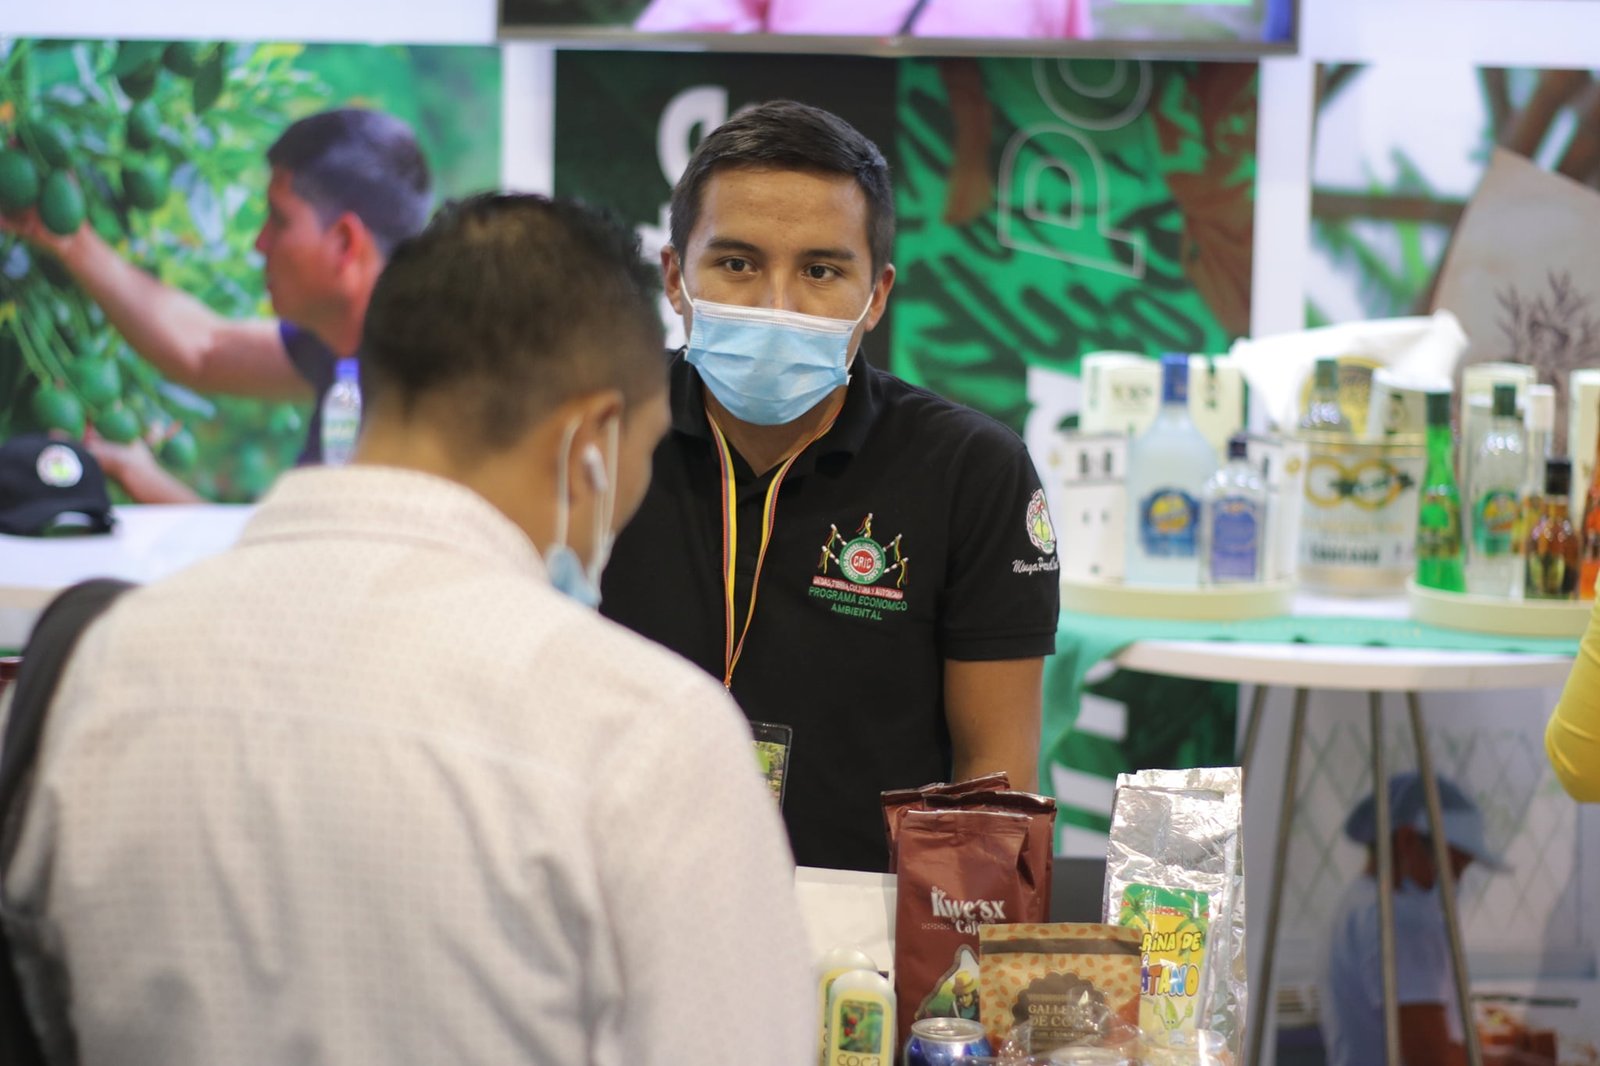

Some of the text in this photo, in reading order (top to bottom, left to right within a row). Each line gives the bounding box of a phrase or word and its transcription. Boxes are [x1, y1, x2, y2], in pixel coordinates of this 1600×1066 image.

[853, 555, 873, 569] CRIC
[808, 586, 857, 603] PROGRAMA
[831, 603, 882, 620] AMBIENTAL
[1181, 931, 1202, 952] DE
